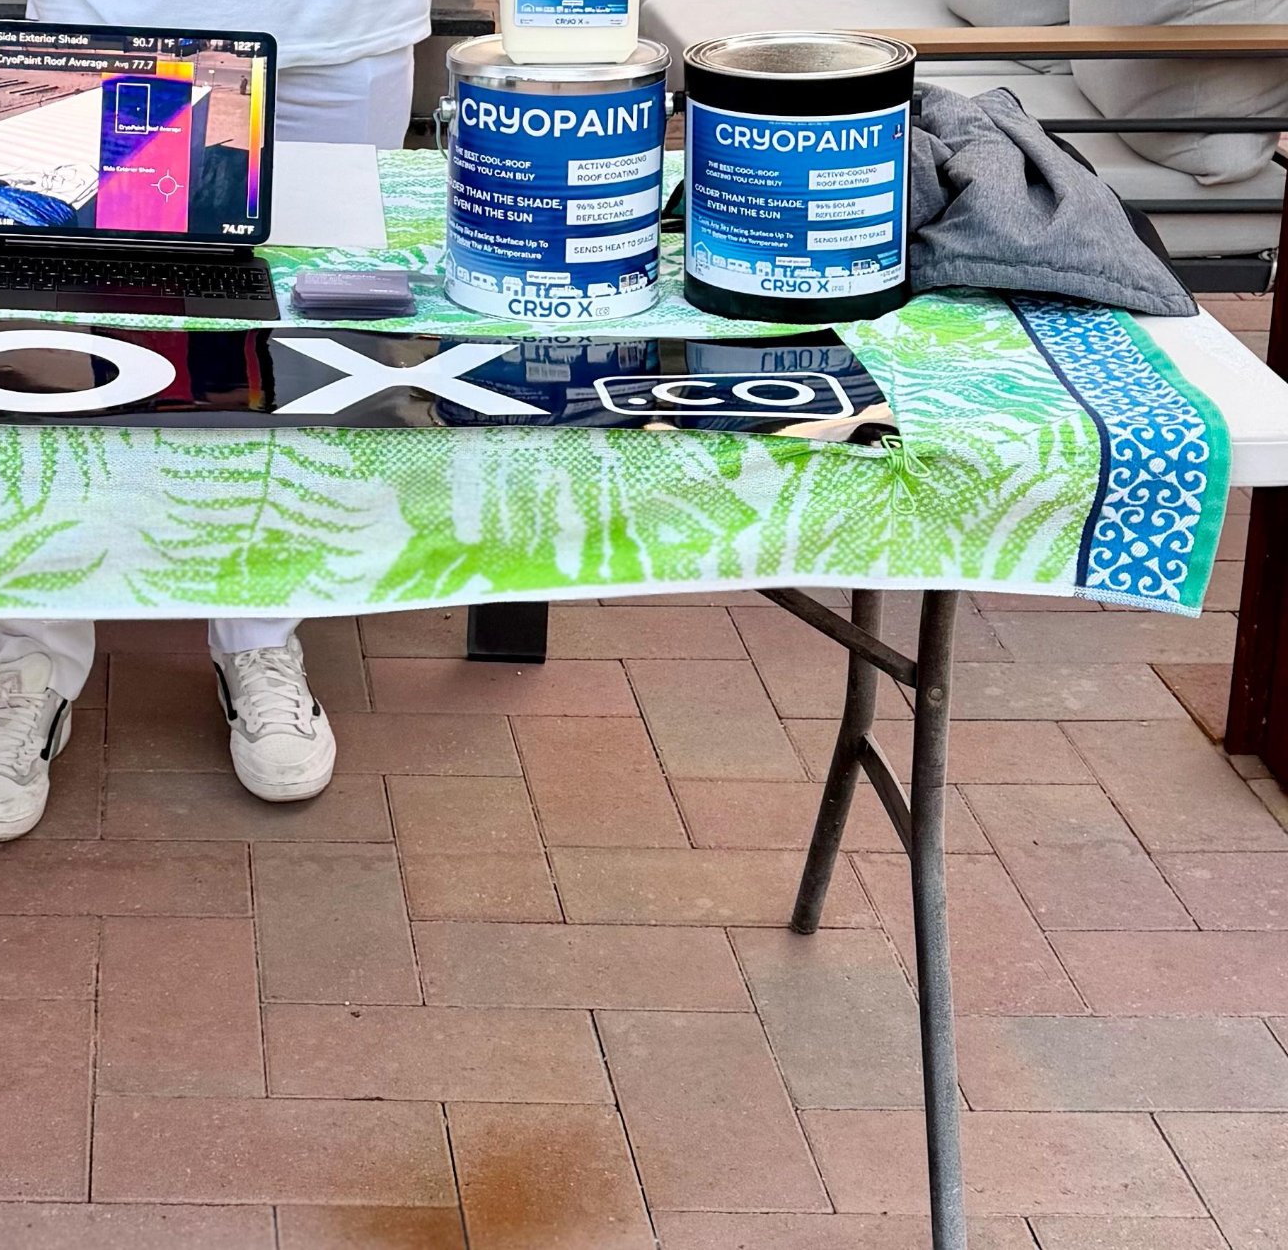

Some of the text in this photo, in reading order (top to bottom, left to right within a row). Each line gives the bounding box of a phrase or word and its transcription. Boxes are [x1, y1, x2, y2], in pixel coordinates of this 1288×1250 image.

[19, 34, 56, 43] Exterior
[58, 34, 88, 44] Shade
[132, 38, 154, 47] 90.7
[44, 56, 66, 66] Roof
[68, 58, 108, 69] Average
[132, 60, 154, 70] 77.7
[462, 98, 652, 138] CRYOPAINT
[716, 123, 882, 153] CRYOPAINT
[455, 145, 532, 169] THE BEST COOL-ROOF
[453, 156, 535, 181] COATING YOU CAN BUY
[577, 168, 639, 182] ROOF COATING
[720, 164, 734, 172] BEST
[735, 167, 780, 177] COOL-ROOF
[706, 170, 731, 180] COATING
[732, 175, 747, 183] YOU
[839, 178, 869, 186] COATING
[466, 186, 490, 201] THAN
[493, 193, 514, 205] THE
[516, 197, 562, 210] SHADE,
[695, 184, 720, 198] COLDER
[721, 192, 745, 203] THAN
[747, 196, 765, 206] THE
[454, 196, 532, 223] EVEN IN THE SUN
[597, 200, 624, 209] SOLAR
[708, 200, 780, 219] EVEN IN THE SUN
[576, 209, 634, 222] REFLECTANCE
[815, 210, 865, 218] REFLECTANCE
[730, 226, 749, 235] Facing
[750, 229, 774, 237] Surface
[472, 240, 482, 250] The
[484, 244, 493, 252] Air
[474, 230, 494, 243] Facing
[496, 235, 524, 247] Surface
[526, 239, 537, 249] Up
[538, 240, 548, 248] To
[574, 233, 654, 254] SENDS HEAT TO SPACE
[748, 238, 788, 247] Temperature
[761, 279, 811, 292] CRYO
[817, 280, 829, 293] X
[508, 299, 571, 318] CRYO
[577, 301, 593, 318] X
[271, 337, 553, 415] X
[627, 377, 815, 406] .CO
